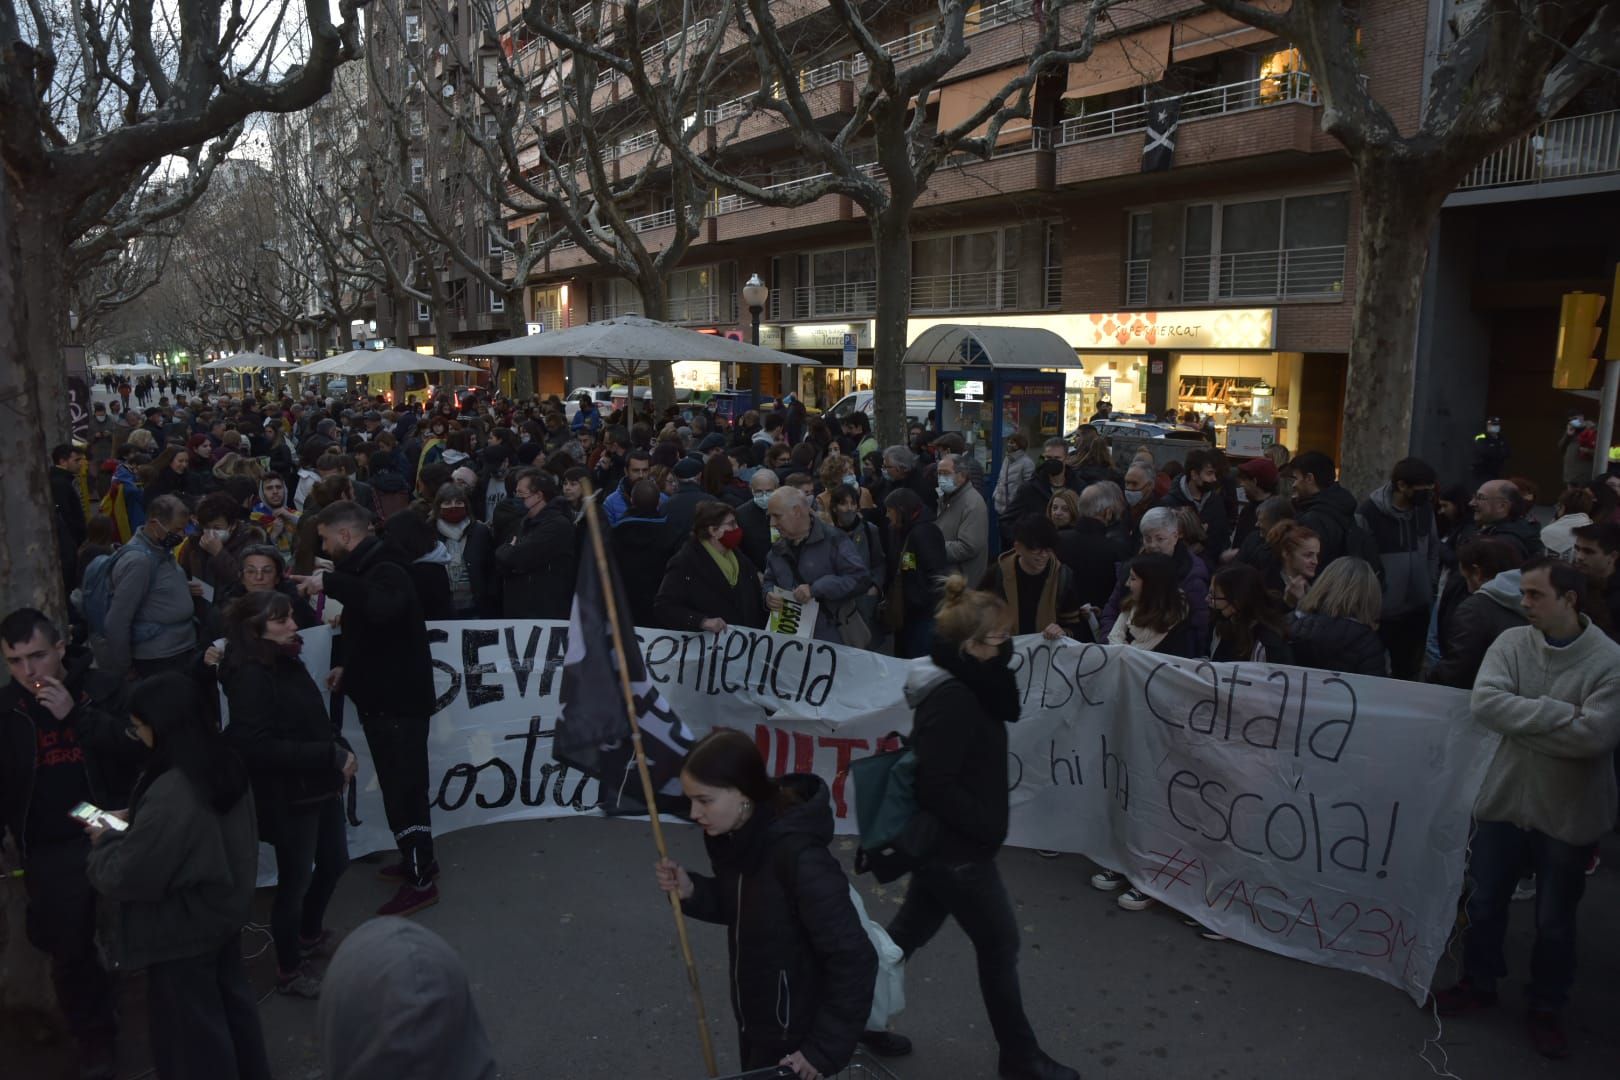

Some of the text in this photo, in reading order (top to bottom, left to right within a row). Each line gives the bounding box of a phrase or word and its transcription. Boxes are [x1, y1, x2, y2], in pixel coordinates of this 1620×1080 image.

[528, 325, 541, 336] P
[633, 630, 836, 706] entencia
[1051, 739, 1083, 786] hi
[1167, 769, 1399, 880] escola!
[1142, 848, 1417, 978] #VAGA23M
